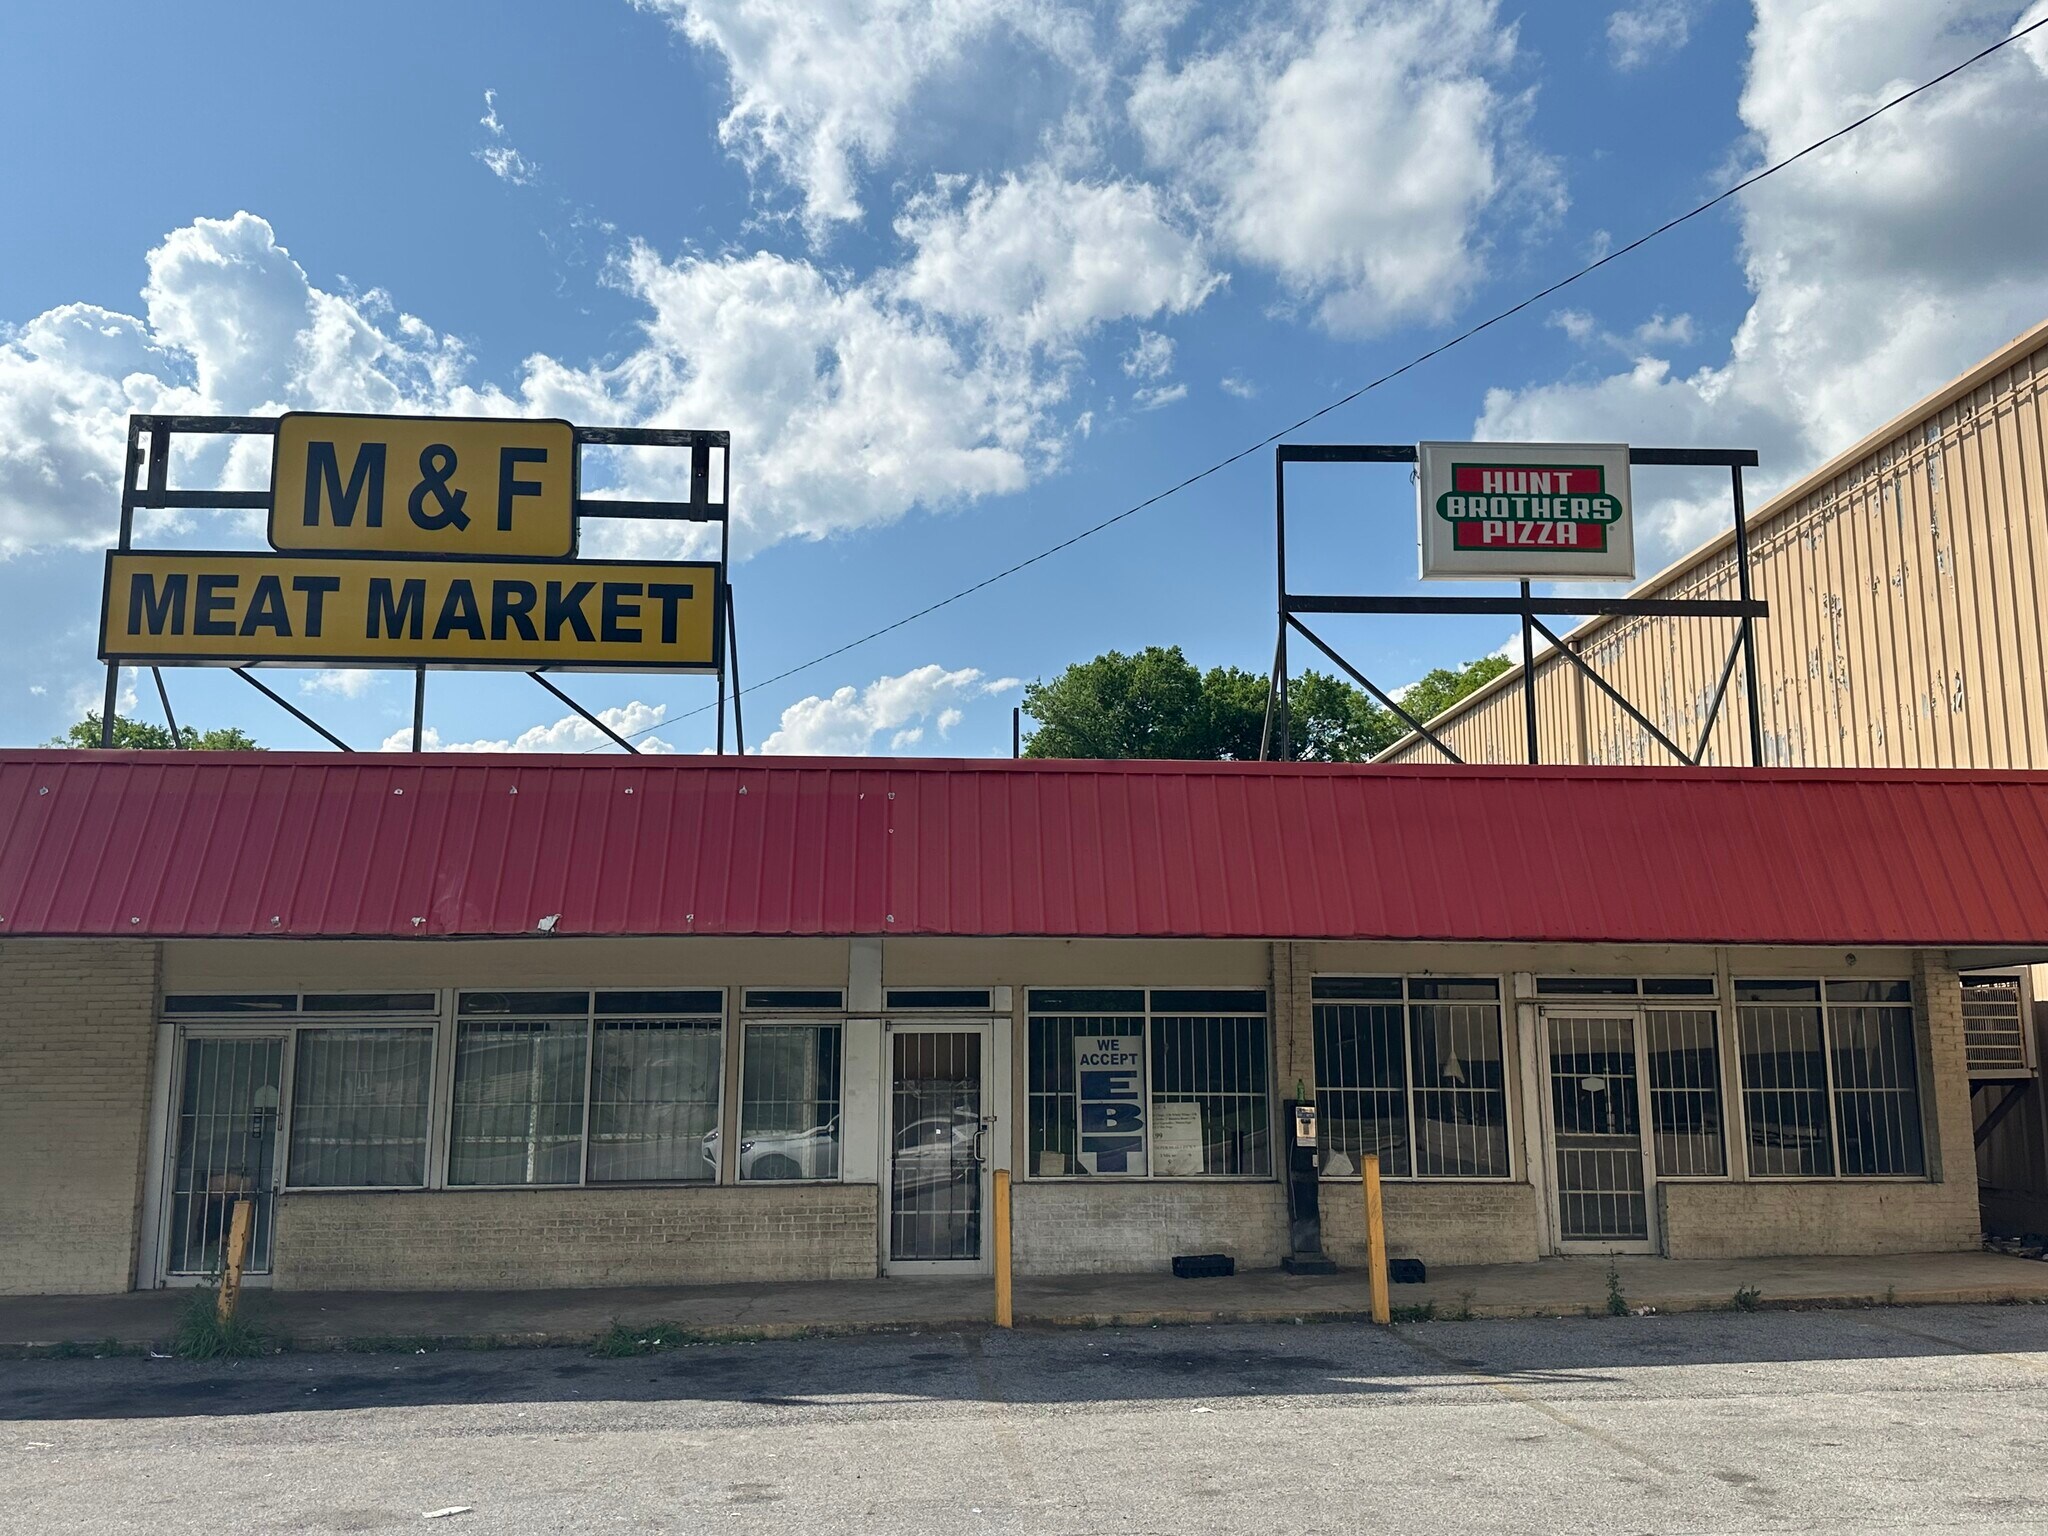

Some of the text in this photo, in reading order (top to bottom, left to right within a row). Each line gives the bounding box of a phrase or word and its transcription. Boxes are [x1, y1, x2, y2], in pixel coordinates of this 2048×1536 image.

[303, 441, 548, 532] M & F
[1482, 471, 1573, 495] HUNT
[1446, 496, 1612, 520] BROTHERS
[1482, 520, 1578, 545] PIZZA
[127, 574, 694, 644] MEAT MARKET
[1097, 1039, 1120, 1051] WE
[1080, 1053, 1138, 1066] ACCEPT
[1080, 1070, 1144, 1172] EBT
